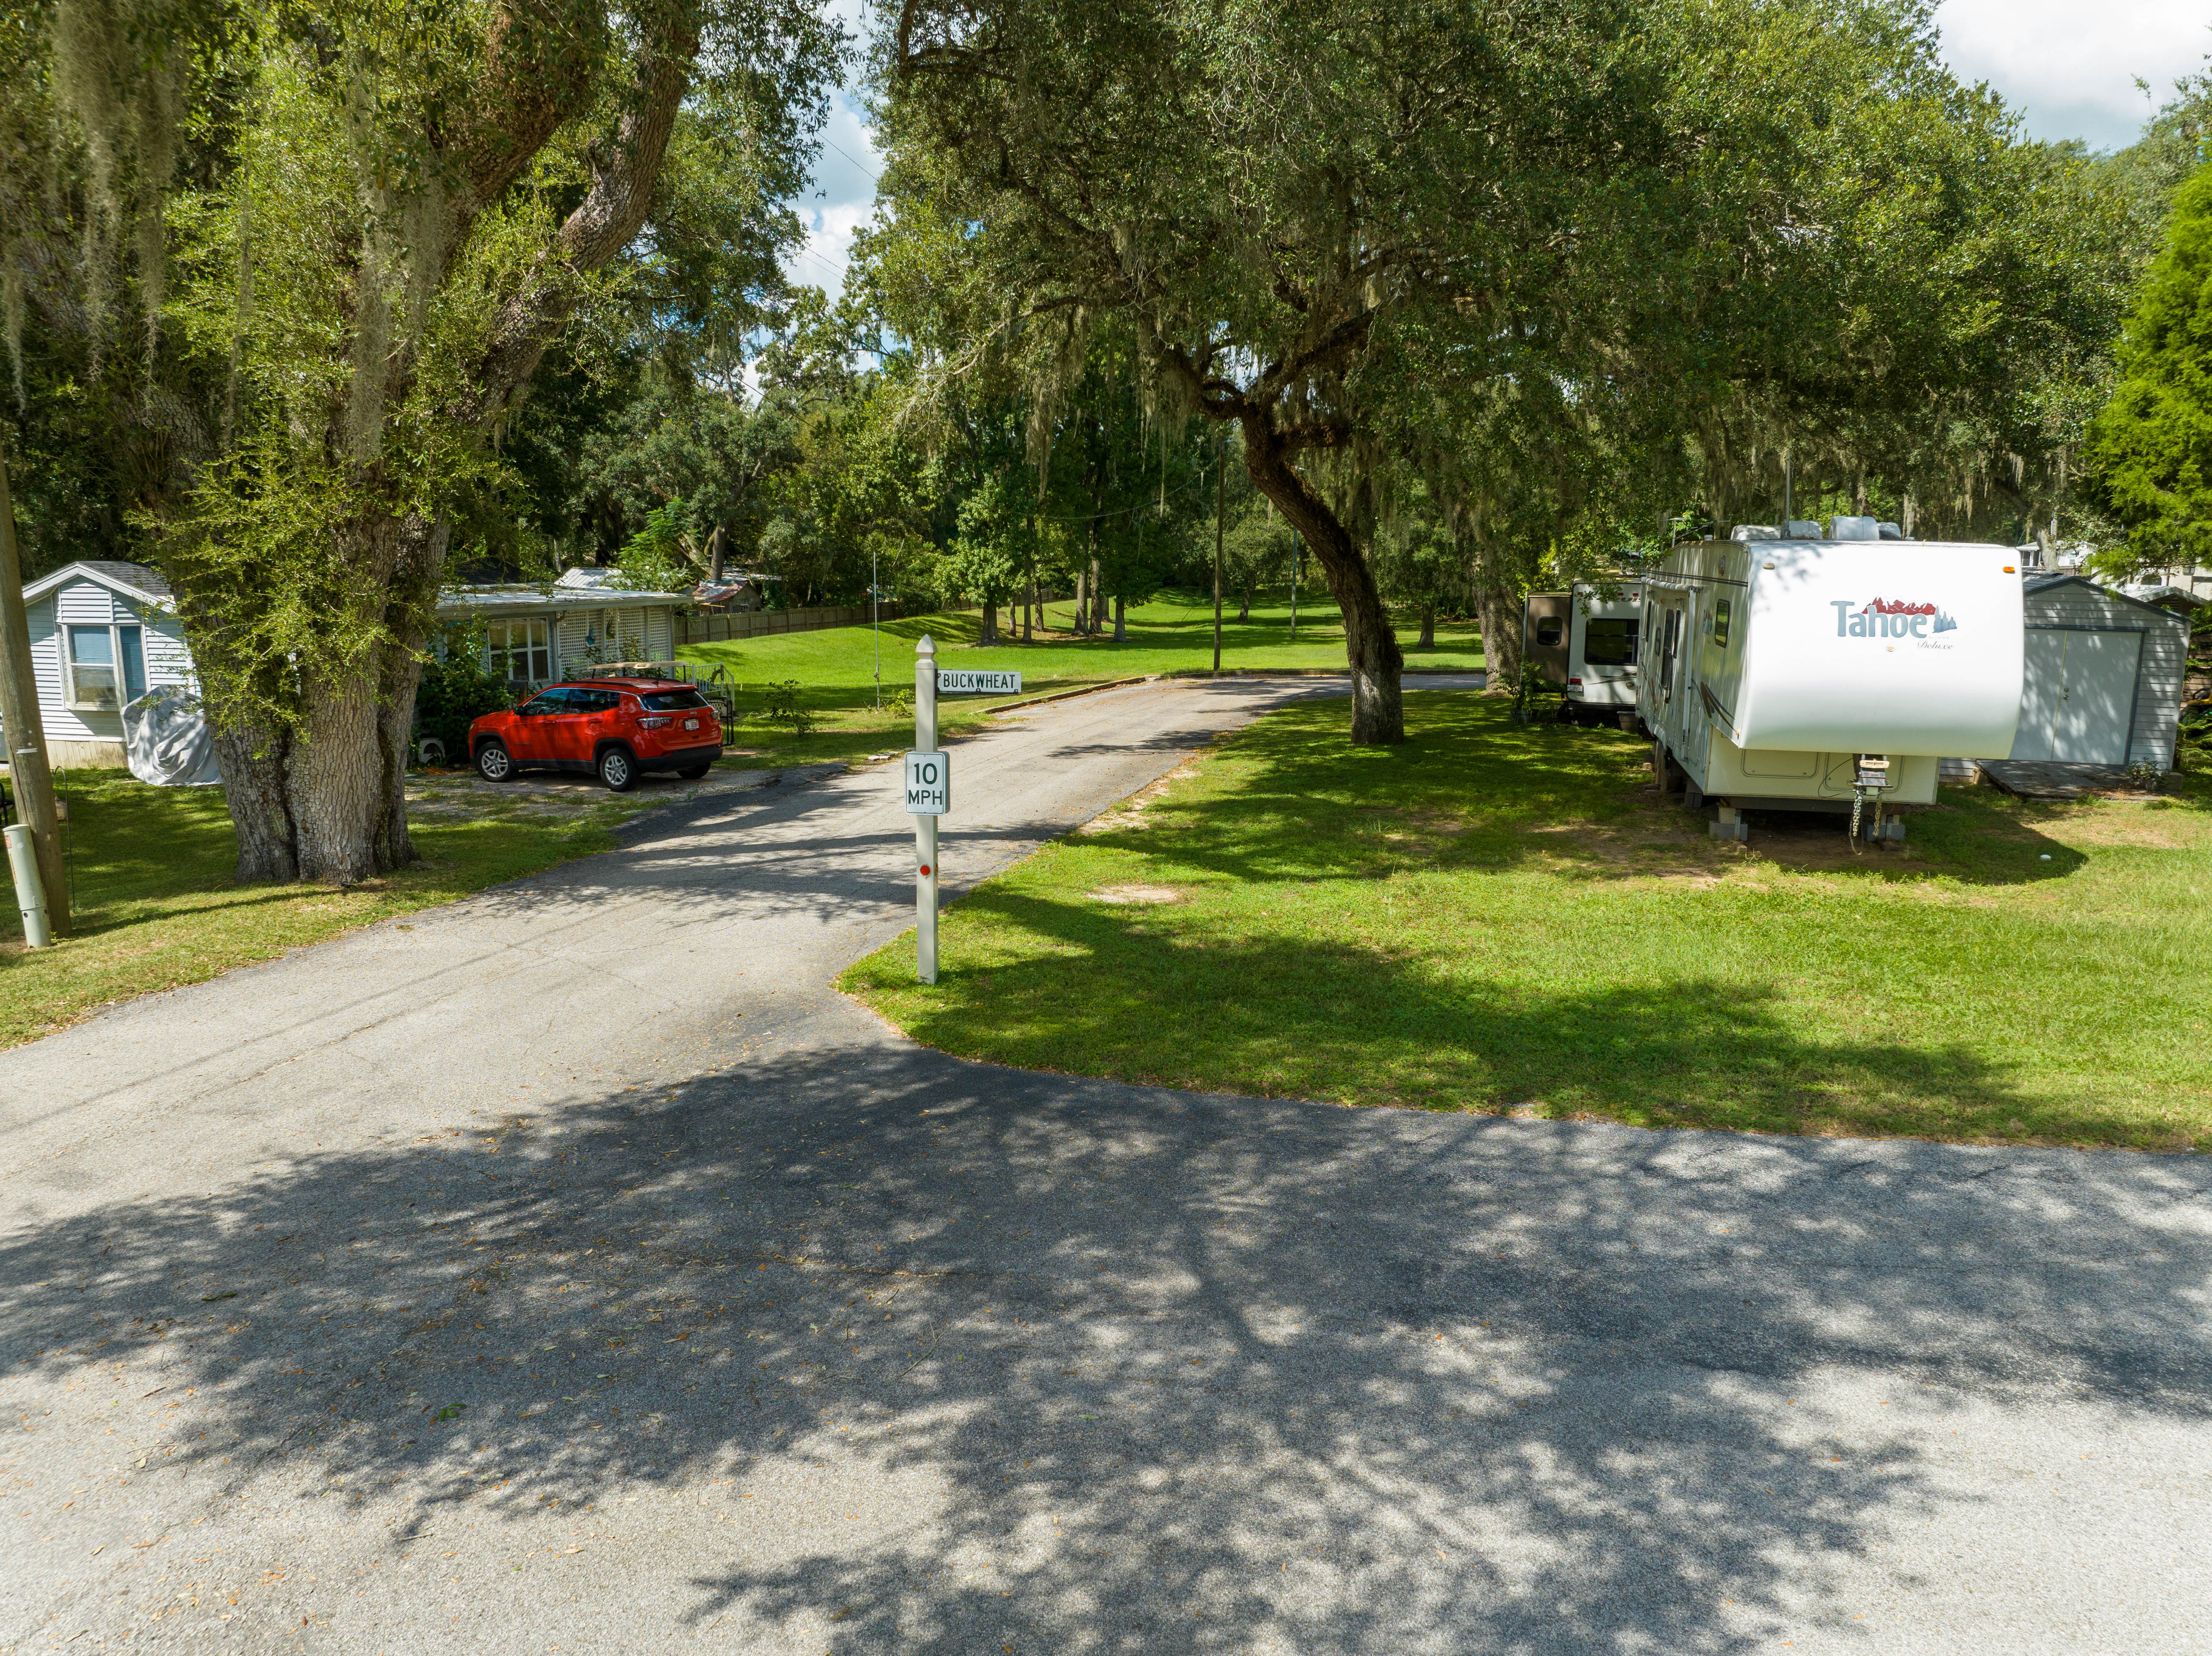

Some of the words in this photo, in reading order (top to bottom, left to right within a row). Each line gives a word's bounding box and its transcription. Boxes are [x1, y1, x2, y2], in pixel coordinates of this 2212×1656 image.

[1830, 601, 1927, 638] Tahoe
[1917, 641, 1953, 650] Deluxe
[944, 674, 1015, 688] BUCKWHEAT
[914, 763, 938, 785] 10
[908, 789, 942, 805] MPH
